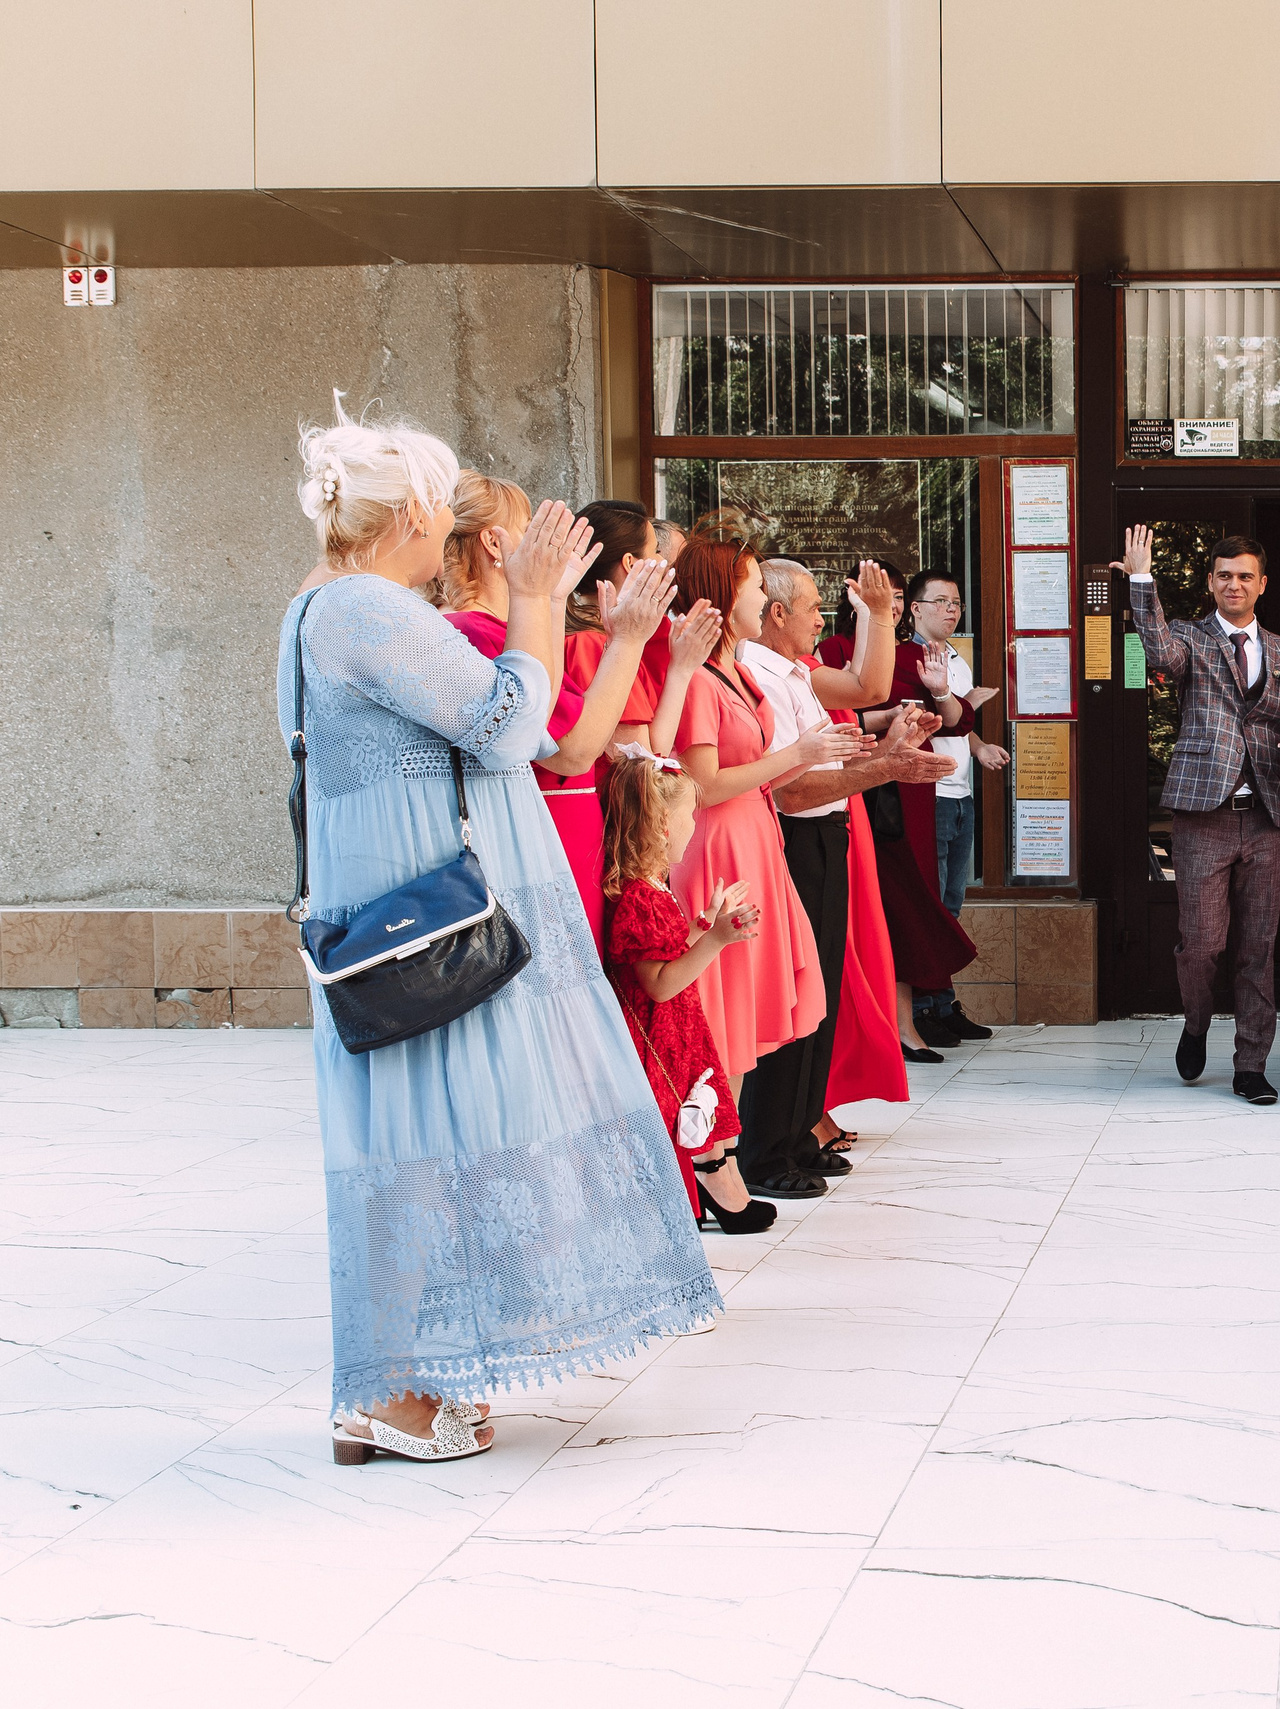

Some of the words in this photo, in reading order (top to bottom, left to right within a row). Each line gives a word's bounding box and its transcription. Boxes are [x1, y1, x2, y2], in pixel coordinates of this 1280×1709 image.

[761, 501, 818, 513] Российская
[825, 501, 879, 513] Федерация
[779, 513, 858, 525] Администрация
[852, 524, 887, 536] района
[793, 537, 849, 548] Волгограда
